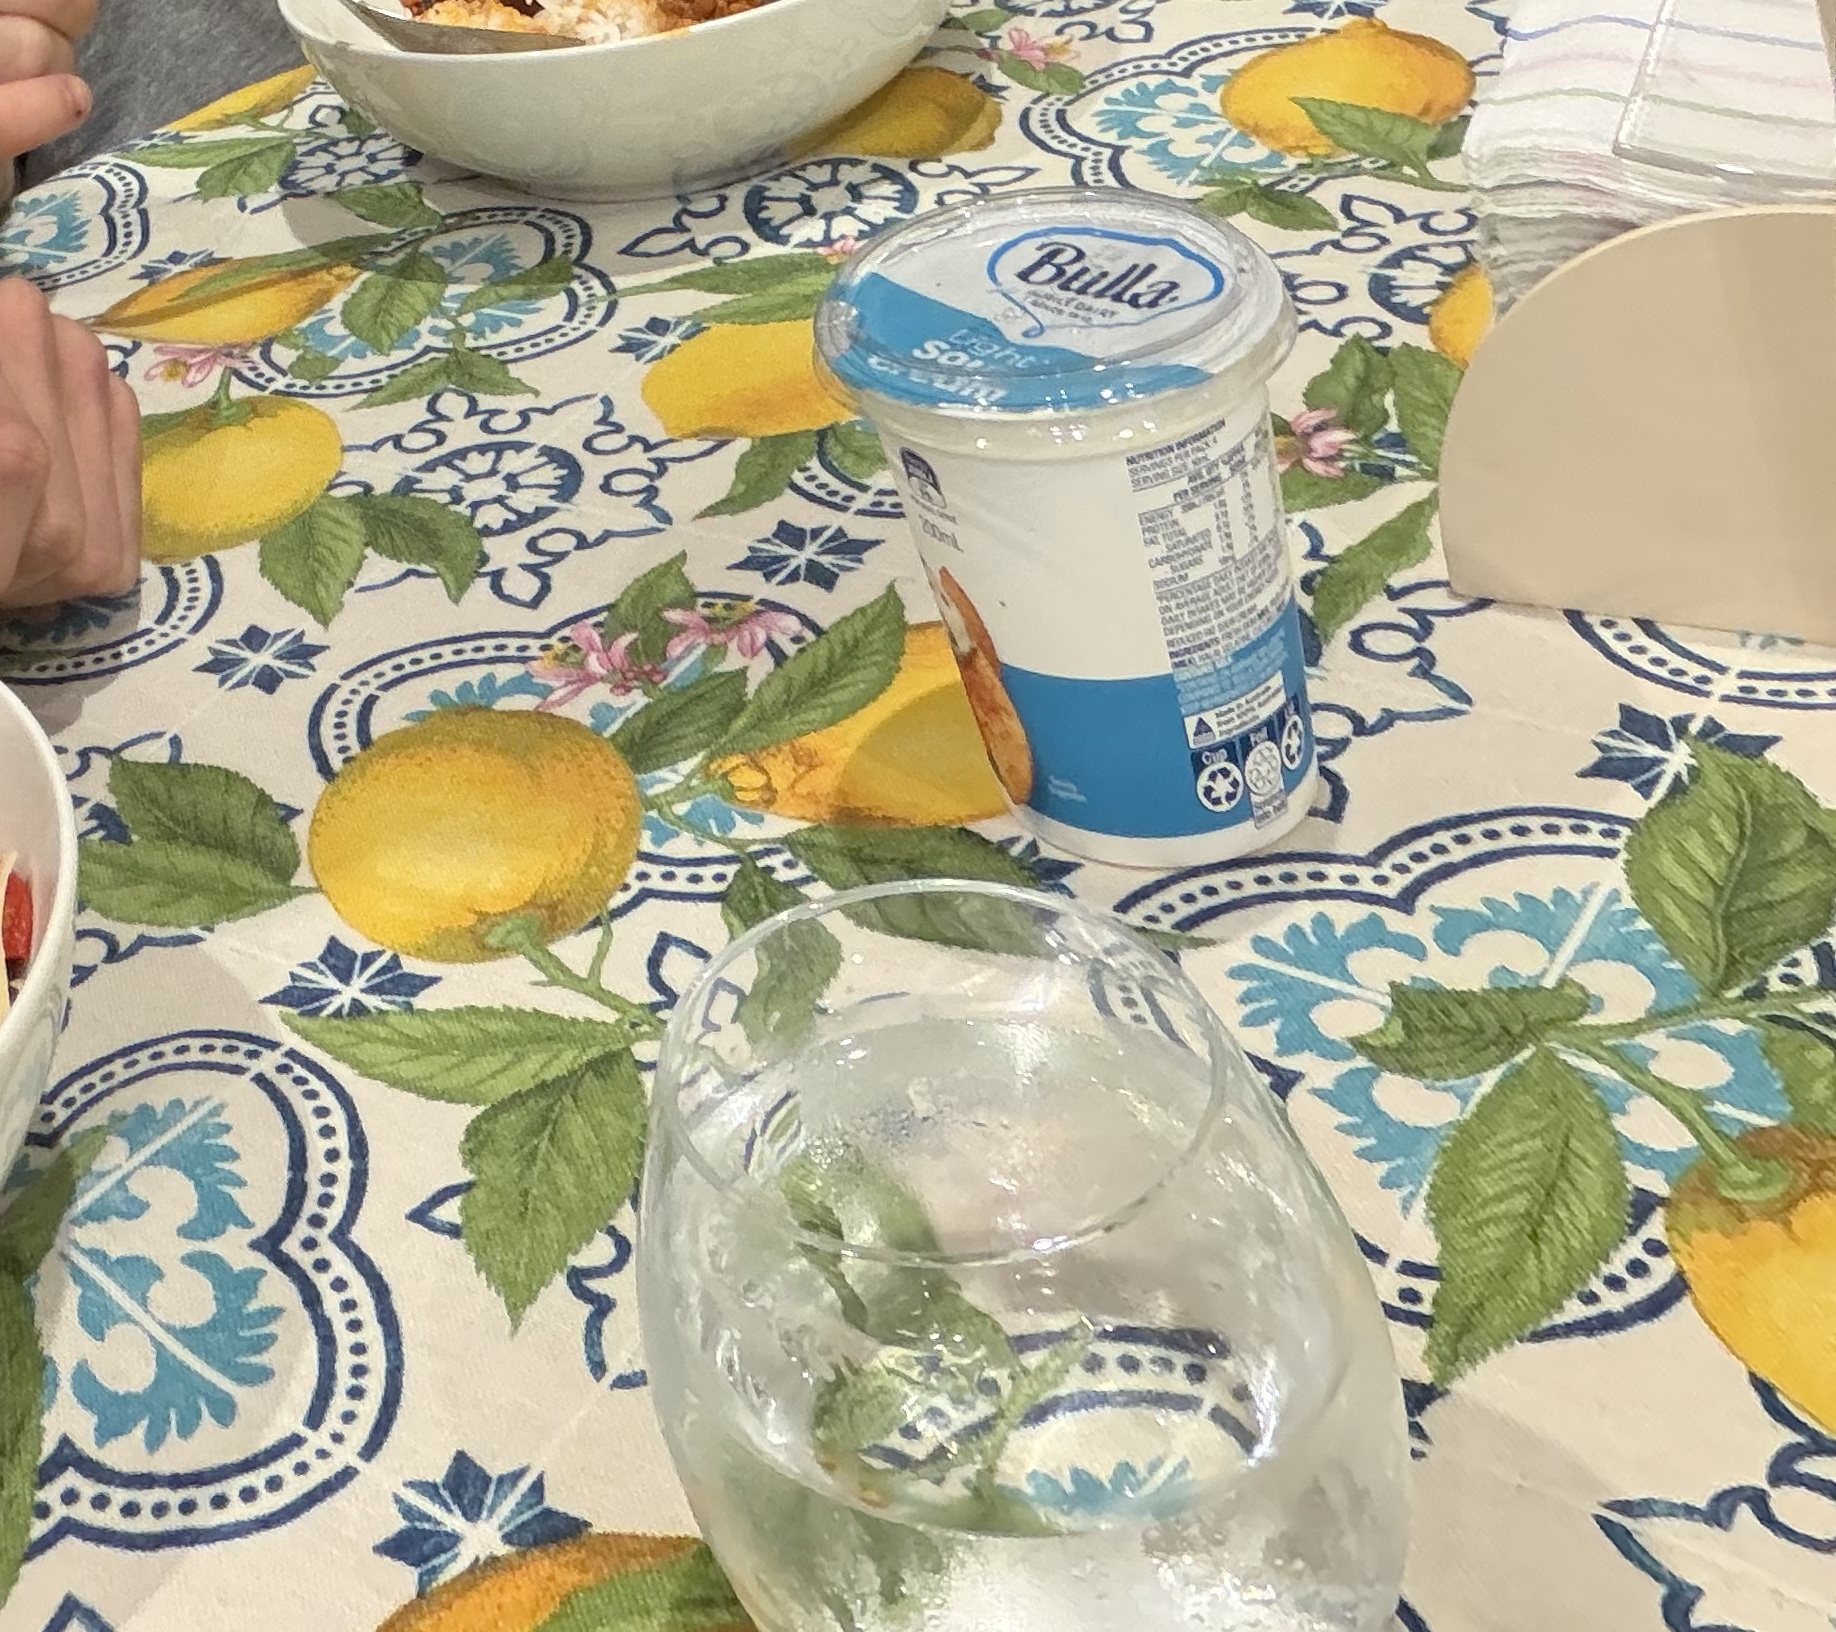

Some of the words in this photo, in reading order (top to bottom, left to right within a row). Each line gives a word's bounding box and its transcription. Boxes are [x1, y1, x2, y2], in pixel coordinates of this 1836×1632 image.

[1014, 240, 1180, 310] Bulla
[950, 328, 1041, 370] Light
[1126, 445, 1175, 466] NUTRITION
[1175, 418, 1226, 449] INFORMATION
[1201, 748, 1229, 766] Cup
